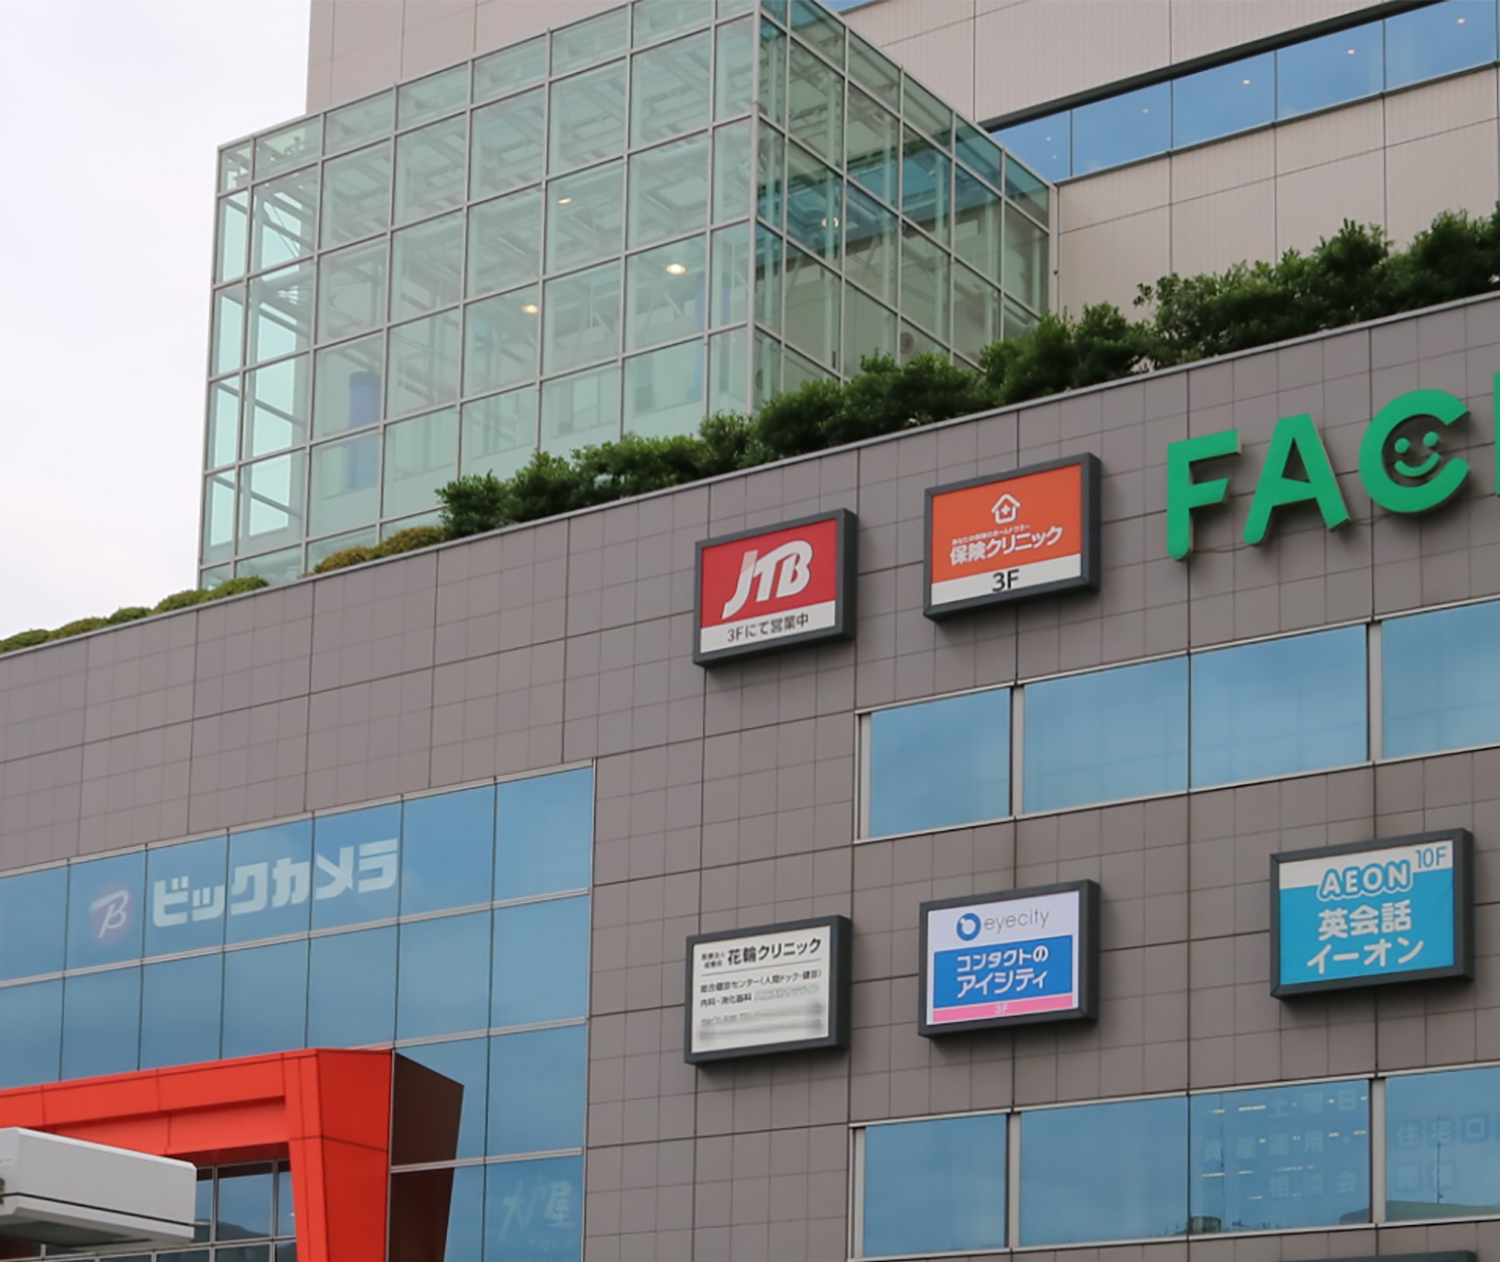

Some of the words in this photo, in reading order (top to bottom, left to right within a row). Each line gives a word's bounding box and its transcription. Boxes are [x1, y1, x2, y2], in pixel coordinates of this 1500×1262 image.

[949, 525, 1064, 566] 保険クリニック
[721, 540, 814, 620] JTB
[991, 568, 1020, 592] 3F
[727, 612, 810, 642] 3Fにて営業中
[1415, 846, 1447, 868] 10F
[152, 838, 399, 928] ビックカメラ
[1321, 862, 1409, 896] AEON
[983, 908, 1050, 935] eyecity
[1318, 899, 1412, 941] 英会話
[727, 937, 822, 966] 花輪クリニック
[956, 945, 1050, 974] コンタクトの
[1306, 938, 1425, 975] イーオン
[956, 967, 1049, 999] アイシティ
